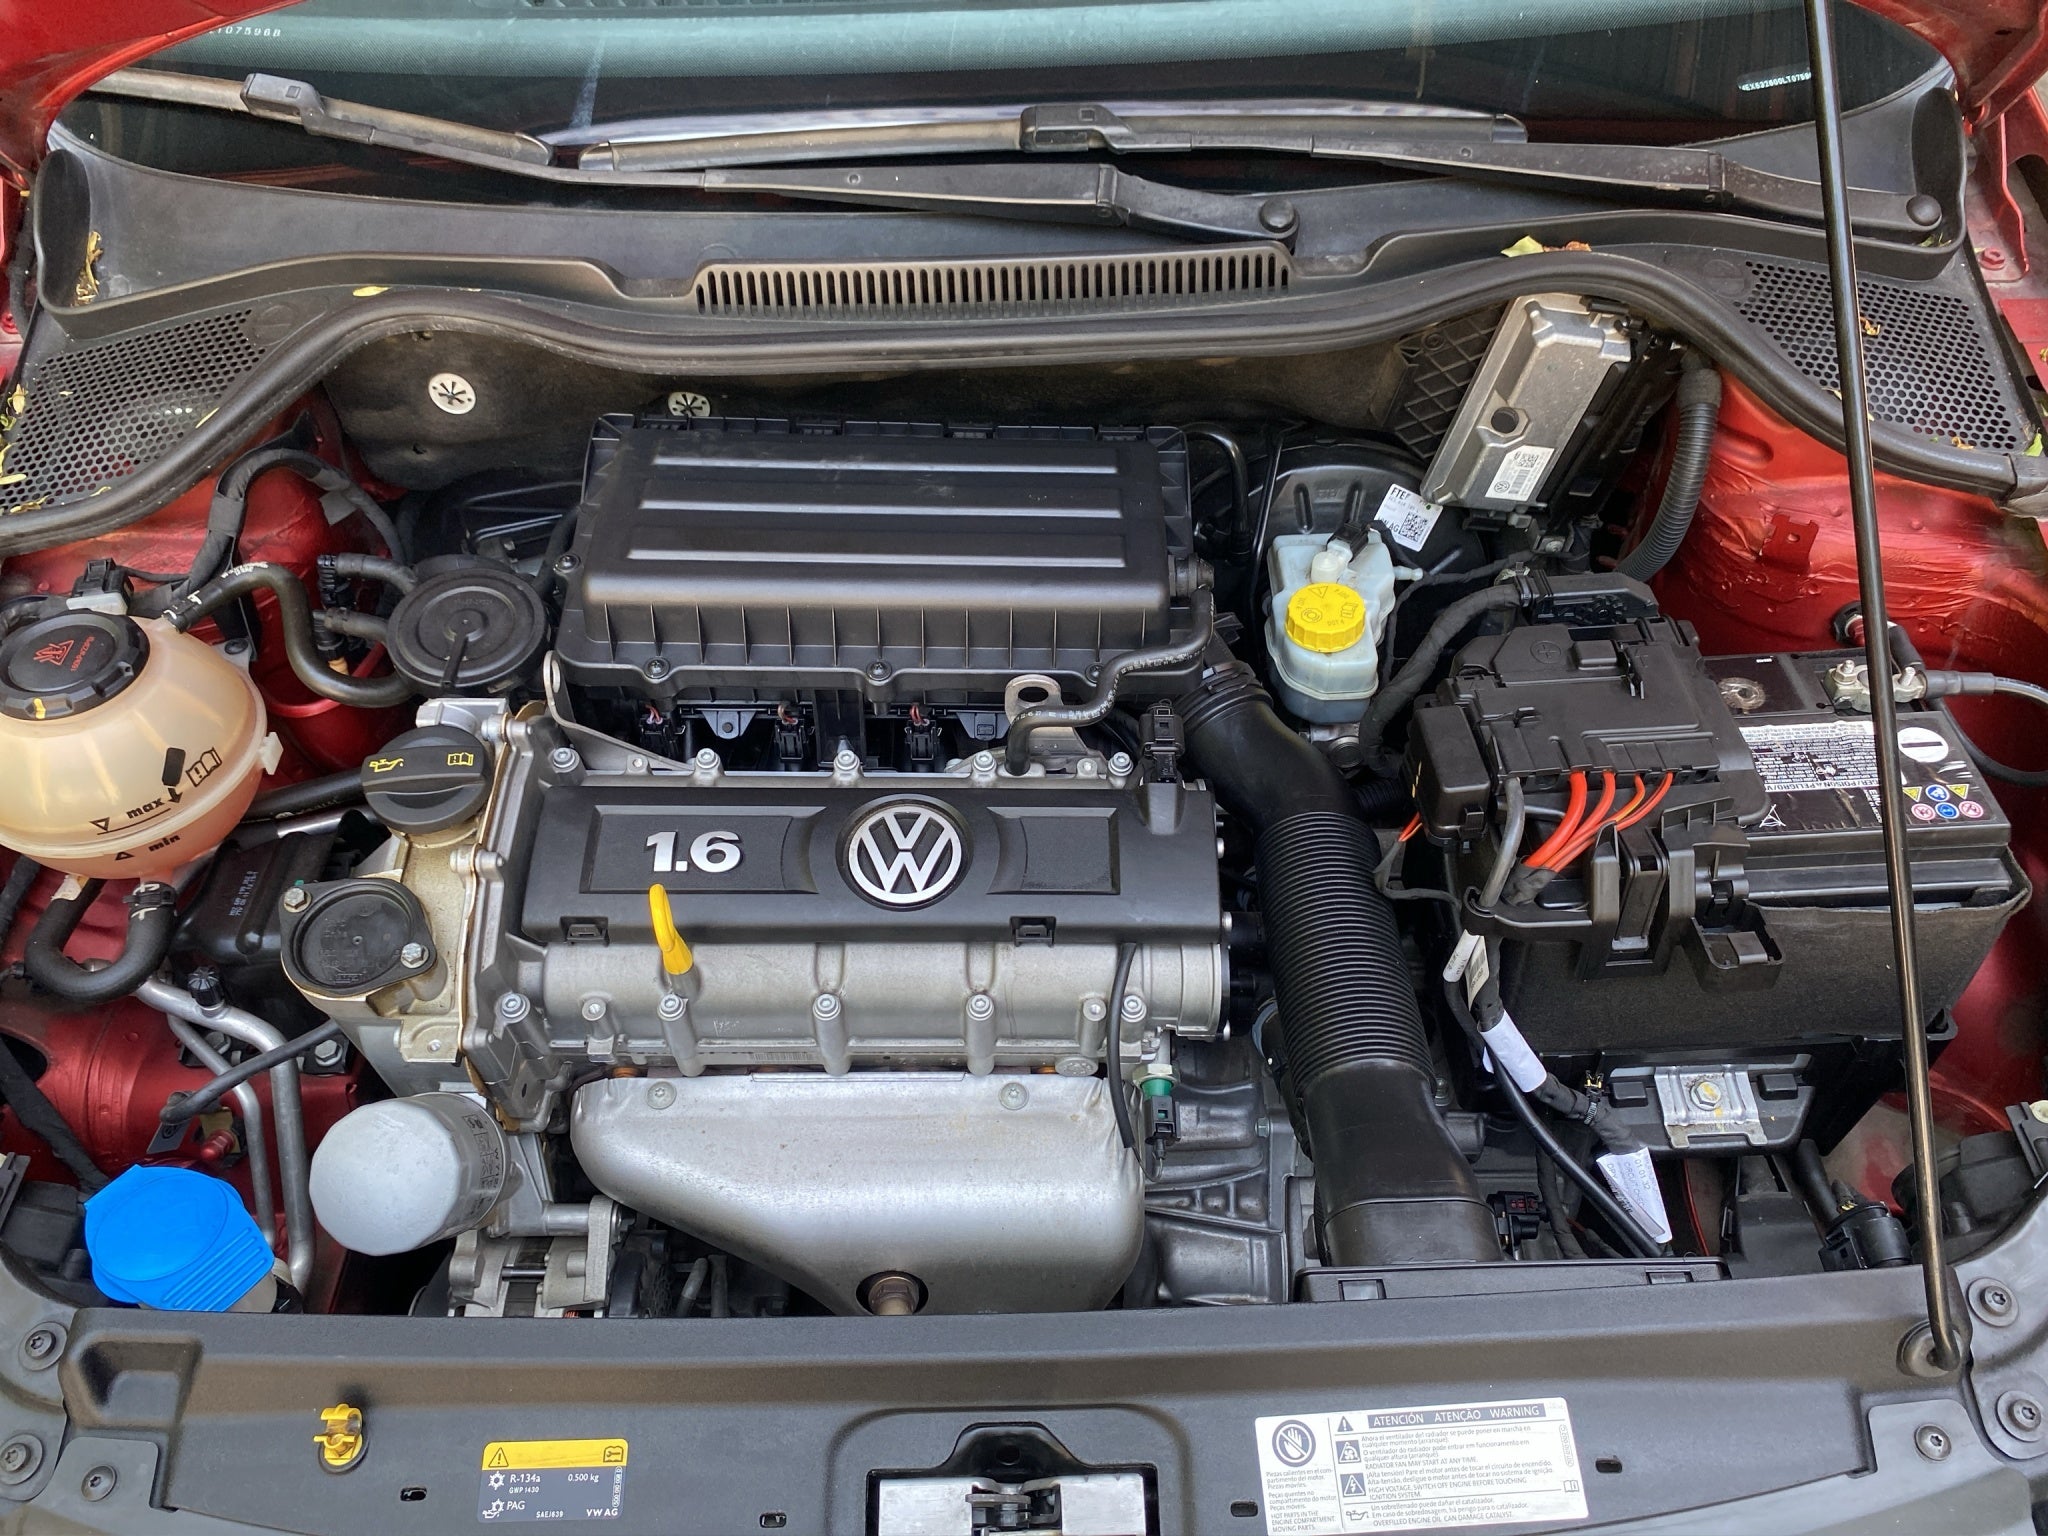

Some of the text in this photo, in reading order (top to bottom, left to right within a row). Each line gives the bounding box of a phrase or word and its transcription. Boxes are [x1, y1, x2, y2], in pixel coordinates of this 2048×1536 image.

[126, 798, 165, 818] max
[148, 835, 180, 852] min
[646, 830, 741, 873] 1.6
[850, 805, 962, 904] VW
[1374, 1411, 1424, 1427] ATENCIÓN
[1435, 1408, 1481, 1423] ATENÇÃO
[1490, 1406, 1540, 1418] WARNING
[510, 1474, 599, 1483] R-134a 0.500 kg
[507, 1500, 526, 1510] PAG
[586, 1508, 618, 1516] VW AG
